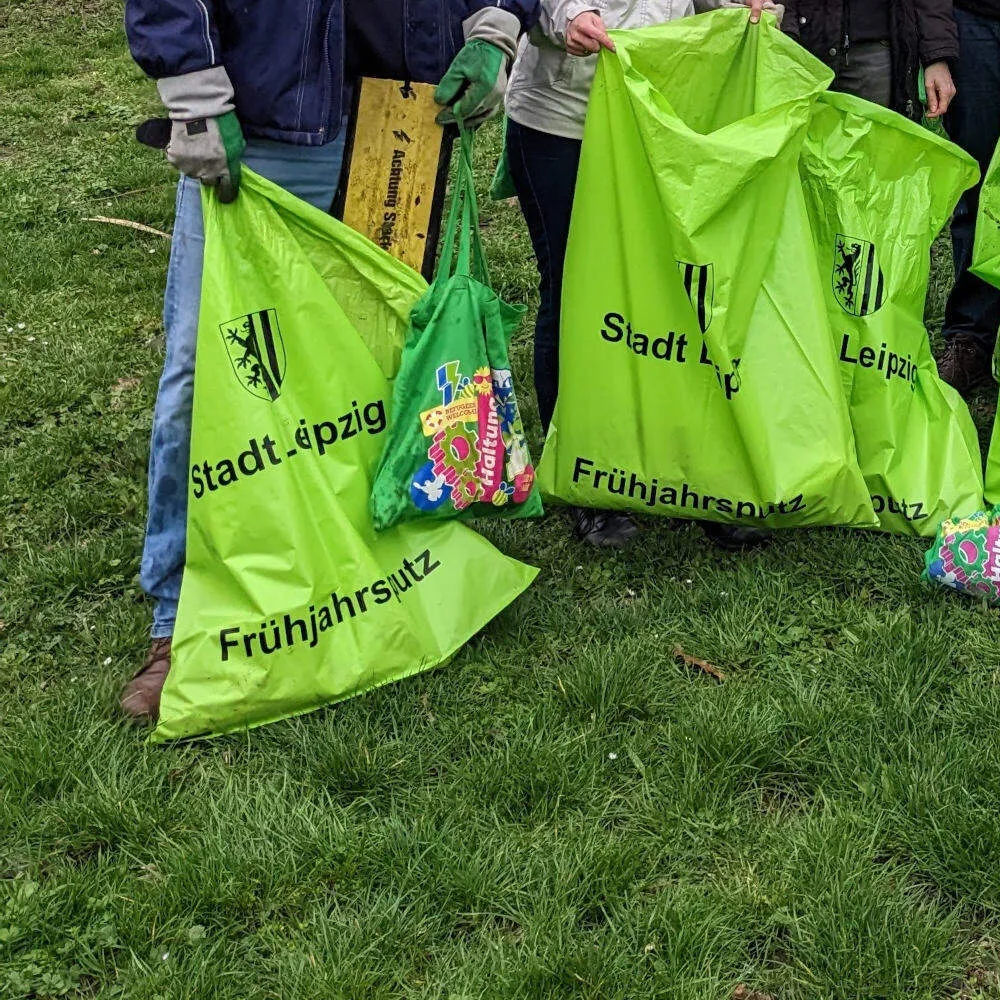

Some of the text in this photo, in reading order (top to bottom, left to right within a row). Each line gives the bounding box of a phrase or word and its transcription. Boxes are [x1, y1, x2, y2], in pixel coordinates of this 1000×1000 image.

[383, 149, 406, 207] Achtung
[601, 312, 688, 363] Stadt
[192, 399, 387, 499] Stadt eipzig
[572, 457, 807, 519] Frühjahrsputz
[219, 549, 442, 661] Frühjahrsputz
